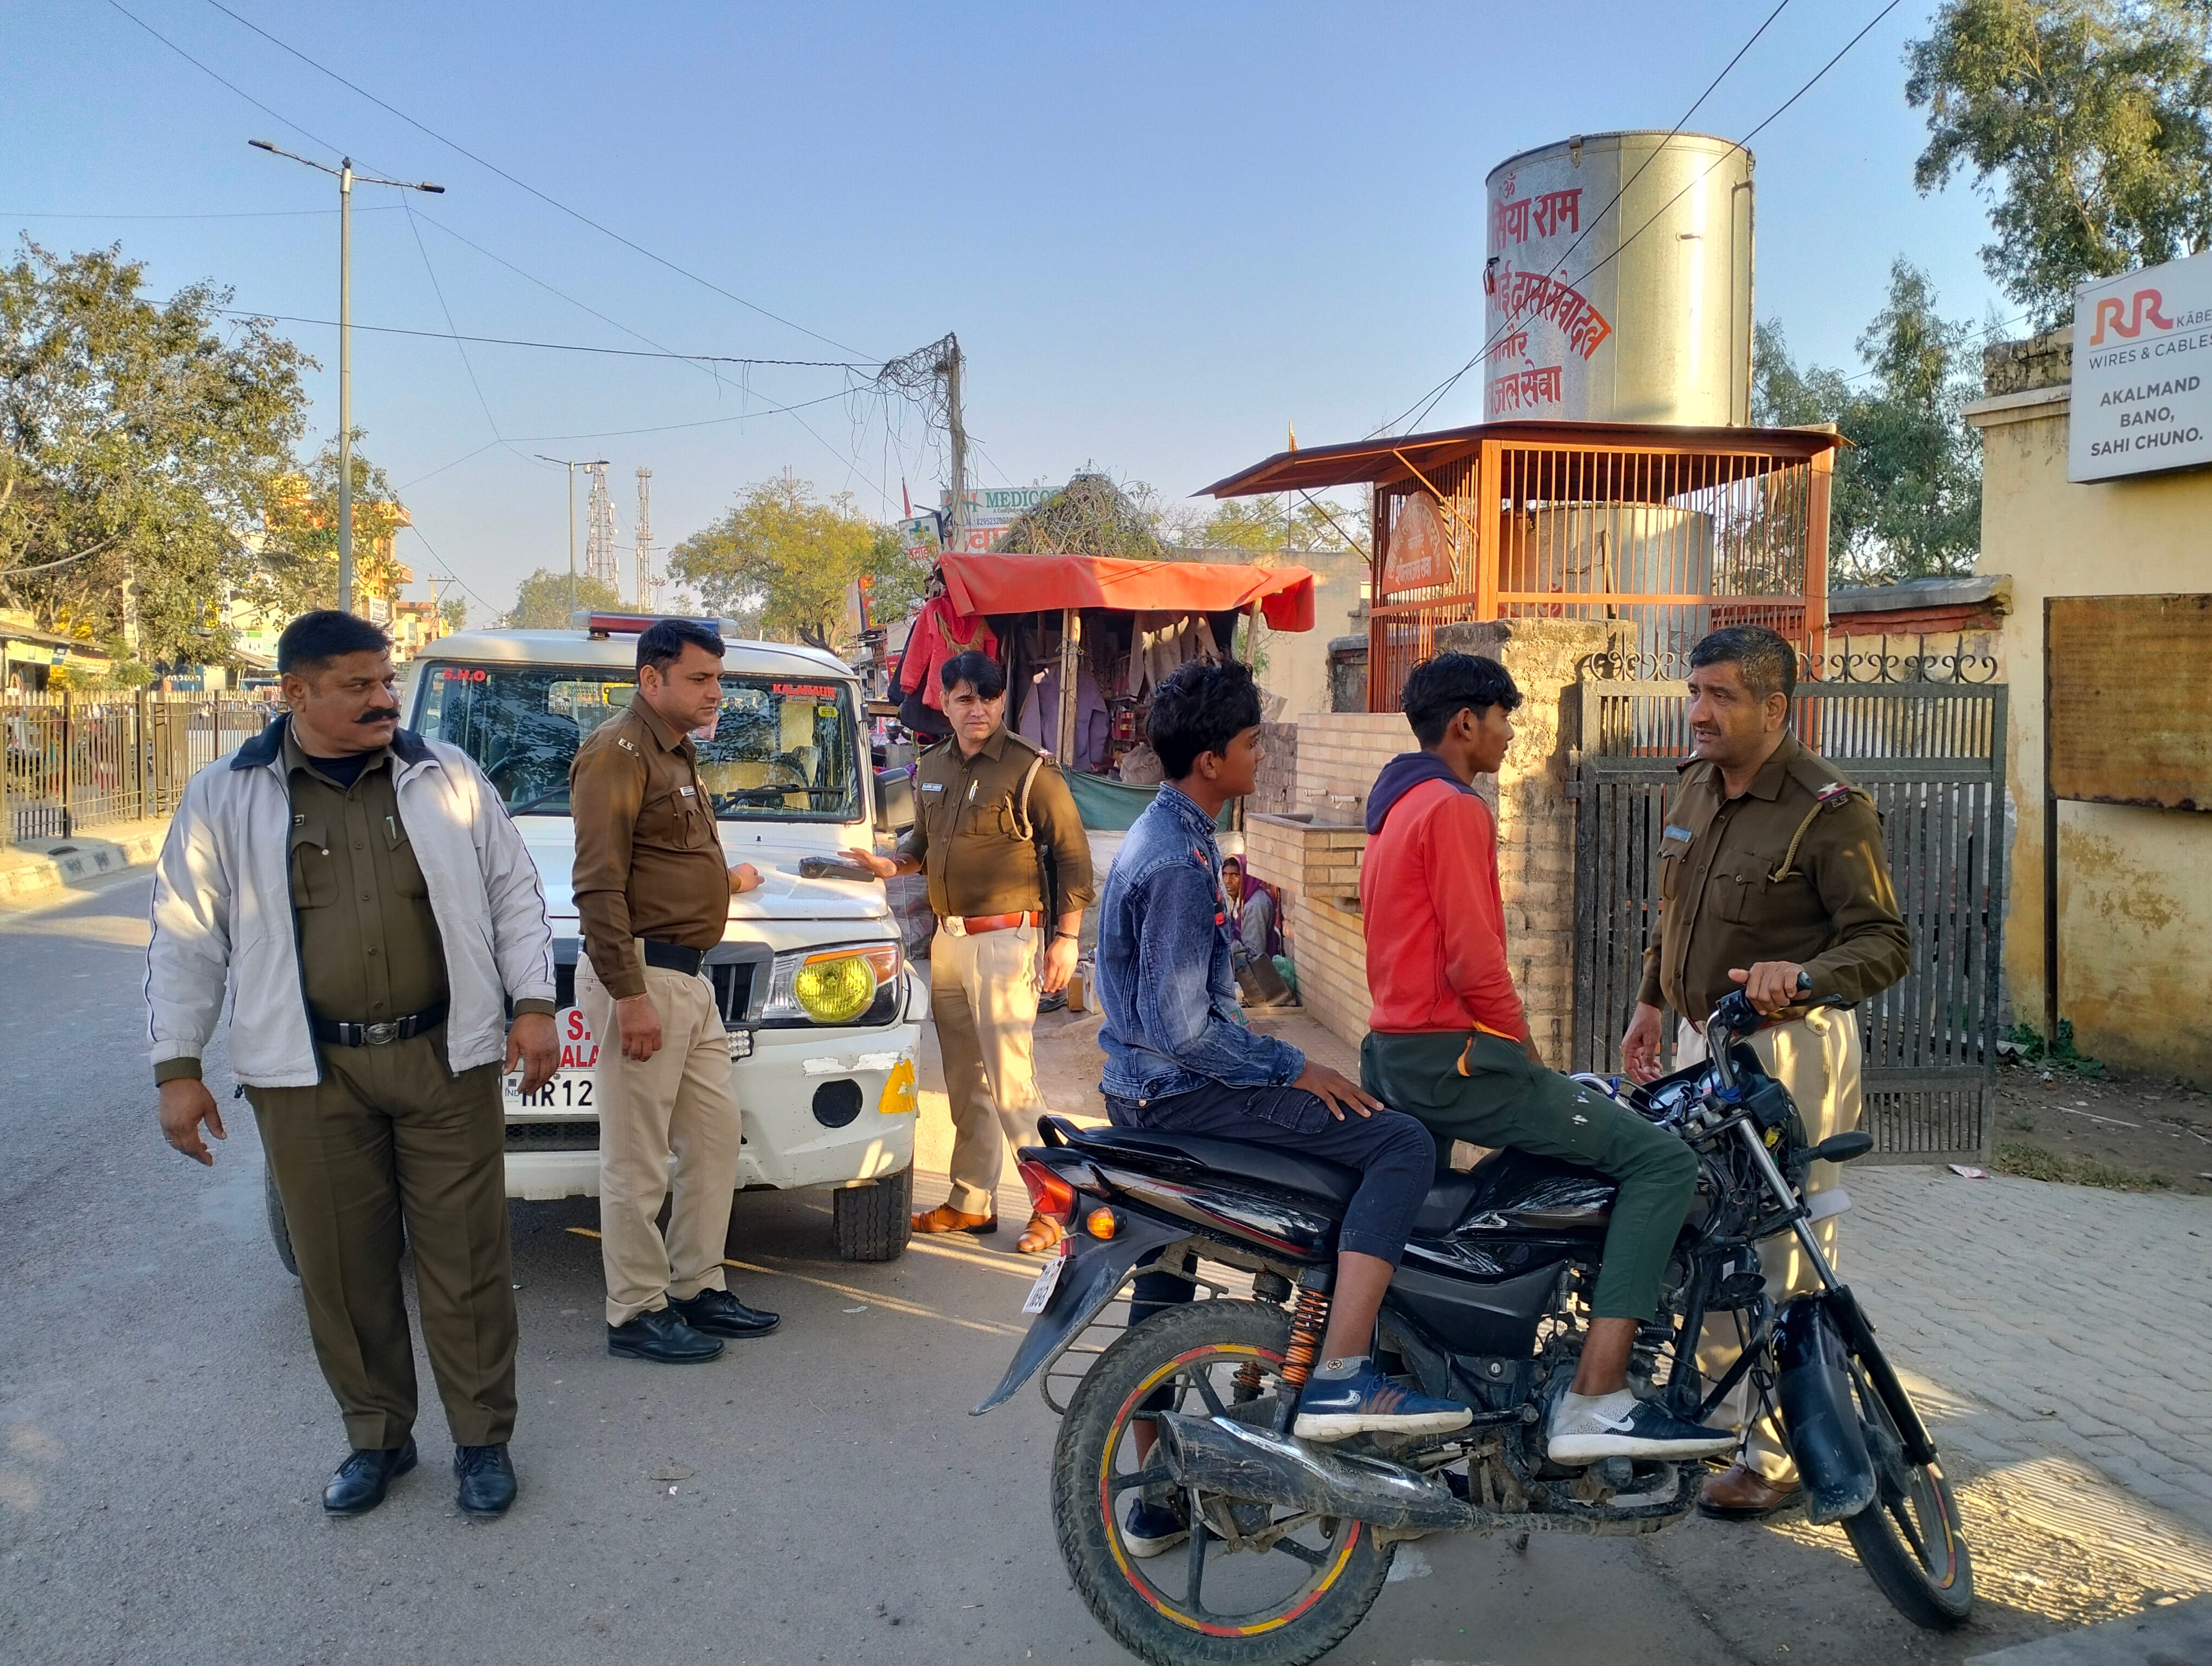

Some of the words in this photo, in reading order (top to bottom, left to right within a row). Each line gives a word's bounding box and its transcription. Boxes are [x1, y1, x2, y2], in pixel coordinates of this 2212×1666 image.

[1532, 188, 1583, 239] राम
[2089, 288, 2174, 347] RR
[2089, 350, 2136, 370] WIRES
[2140, 347, 2151, 360] &
[1520, 358, 1562, 408] सेवा
[2099, 376, 2201, 407] AKALMAND
[2119, 407, 2175, 428] BANO,
[2090, 438, 2130, 457] SAHI
[2134, 427, 2204, 451] CHUNO.
[773, 683, 837, 700] KALANAUR
